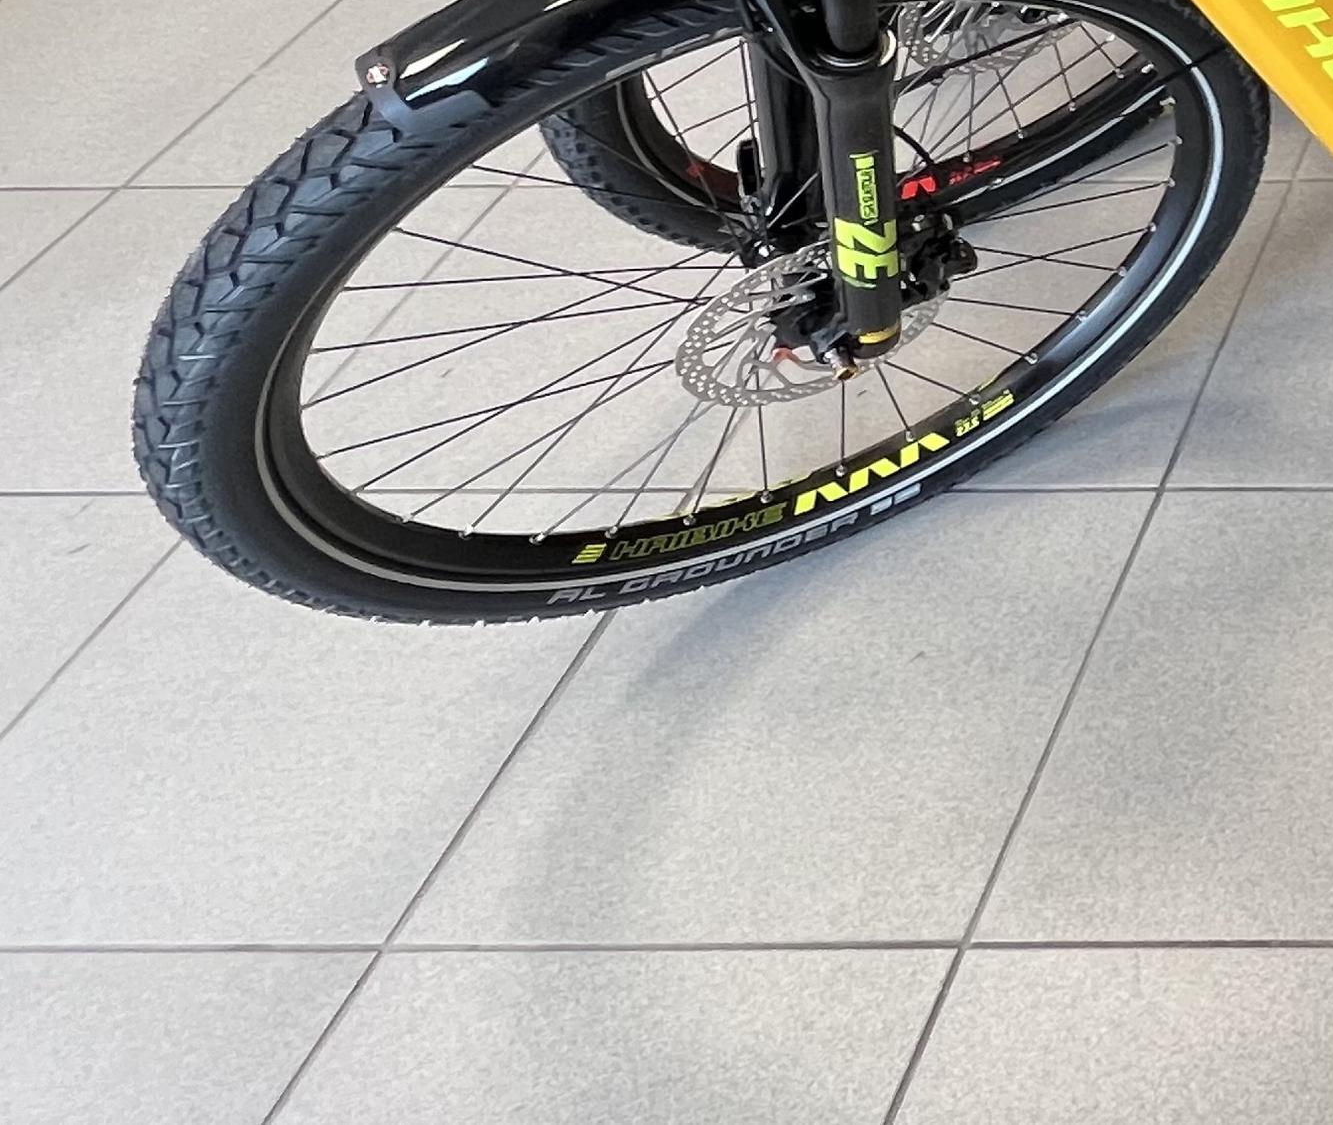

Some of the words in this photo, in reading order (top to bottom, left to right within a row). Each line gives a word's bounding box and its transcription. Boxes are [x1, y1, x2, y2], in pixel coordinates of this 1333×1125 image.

[547, 586, 606, 605] AL
[617, 512, 860, 595] GROUNDER
[611, 502, 788, 562] HAIBIKE
